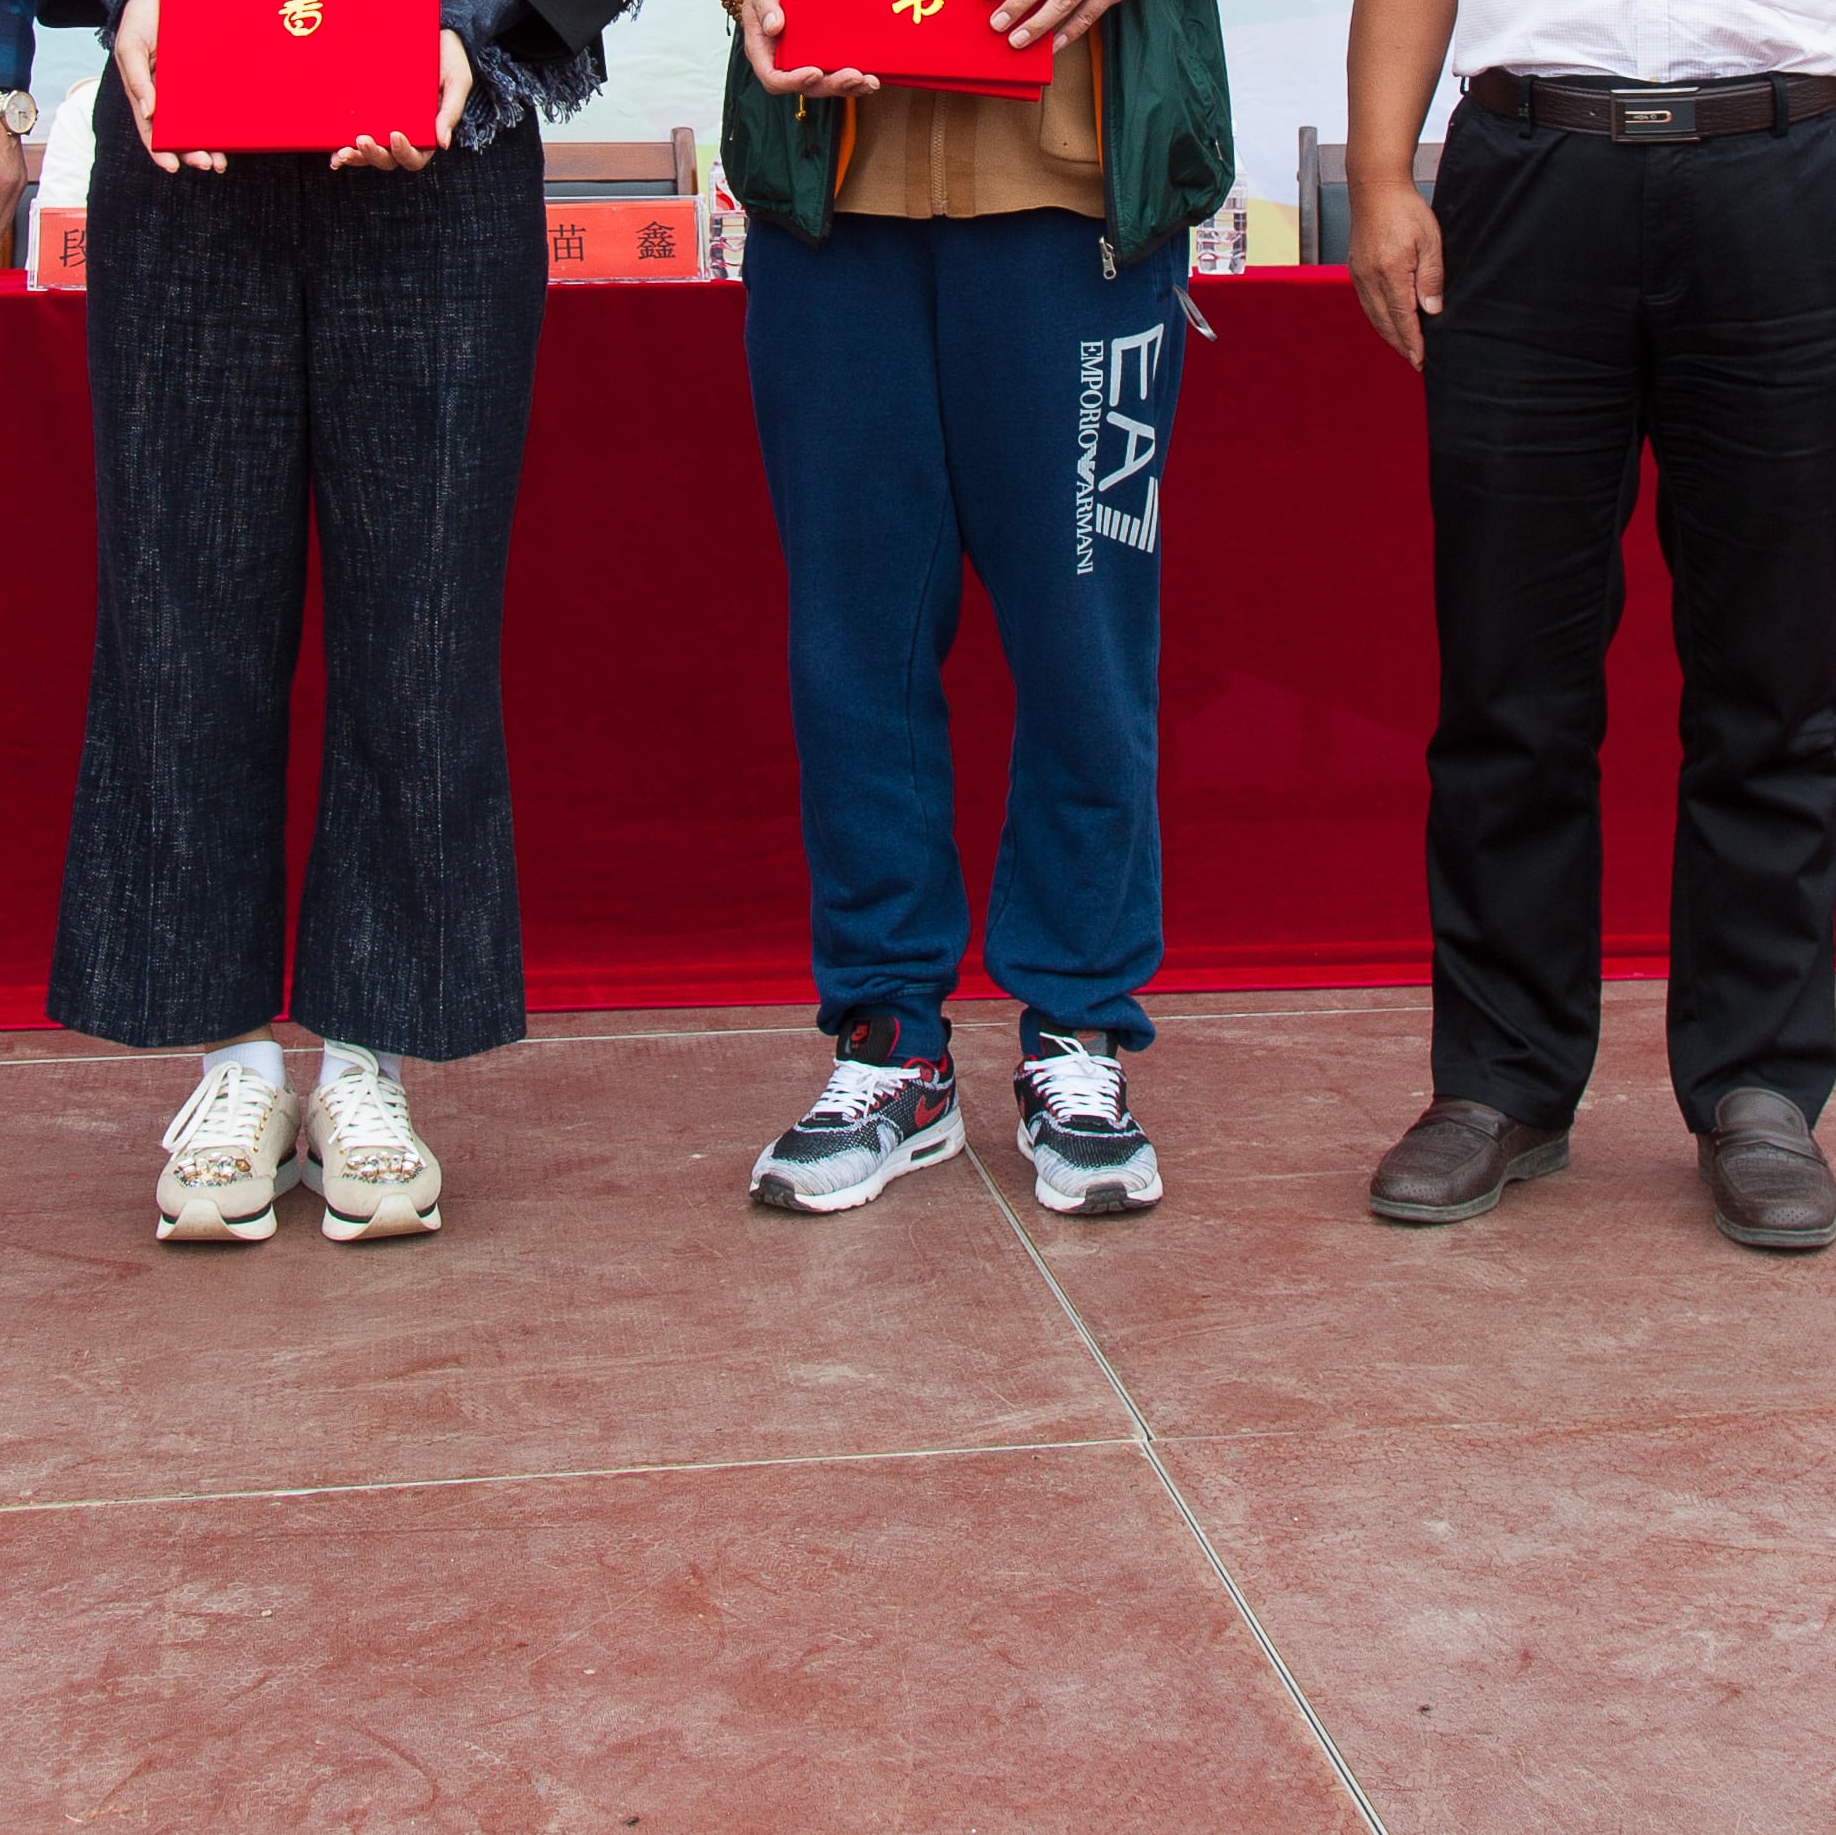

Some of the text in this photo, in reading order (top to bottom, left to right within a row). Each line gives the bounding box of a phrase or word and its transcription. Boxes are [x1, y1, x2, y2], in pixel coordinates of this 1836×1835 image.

[1076, 340, 1104, 576] EMPORIO ARMANI
[1096, 323, 1164, 553] EA7
